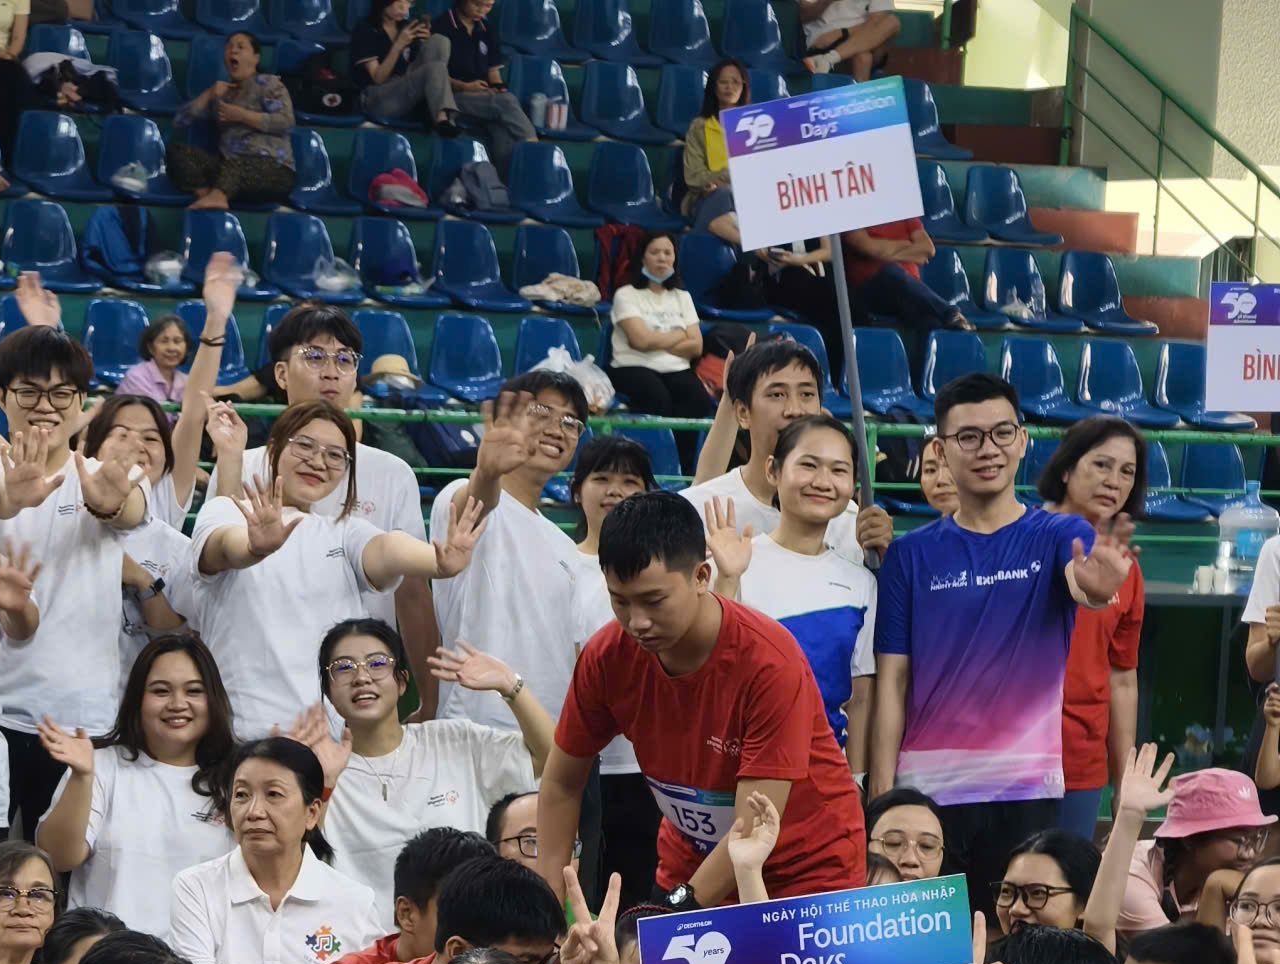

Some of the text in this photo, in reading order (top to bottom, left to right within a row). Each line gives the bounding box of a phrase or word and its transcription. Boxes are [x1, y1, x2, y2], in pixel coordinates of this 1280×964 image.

[808, 95, 897, 122] Foundation
[735, 113, 775, 147] 50
[800, 122, 839, 139] Days
[776, 161, 876, 210] BÌNH TÂN
[1221, 292, 1257, 319] 50
[671, 803, 717, 836] 153
[762, 908, 797, 923] NGÀY
[801, 903, 822, 919] HỘI
[854, 896, 888, 910] THAO
[892, 892, 918, 906] HÒA
[922, 886, 956, 902] NHẬP
[798, 908, 951, 951] Foundation
[703, 946, 725, 958] years
